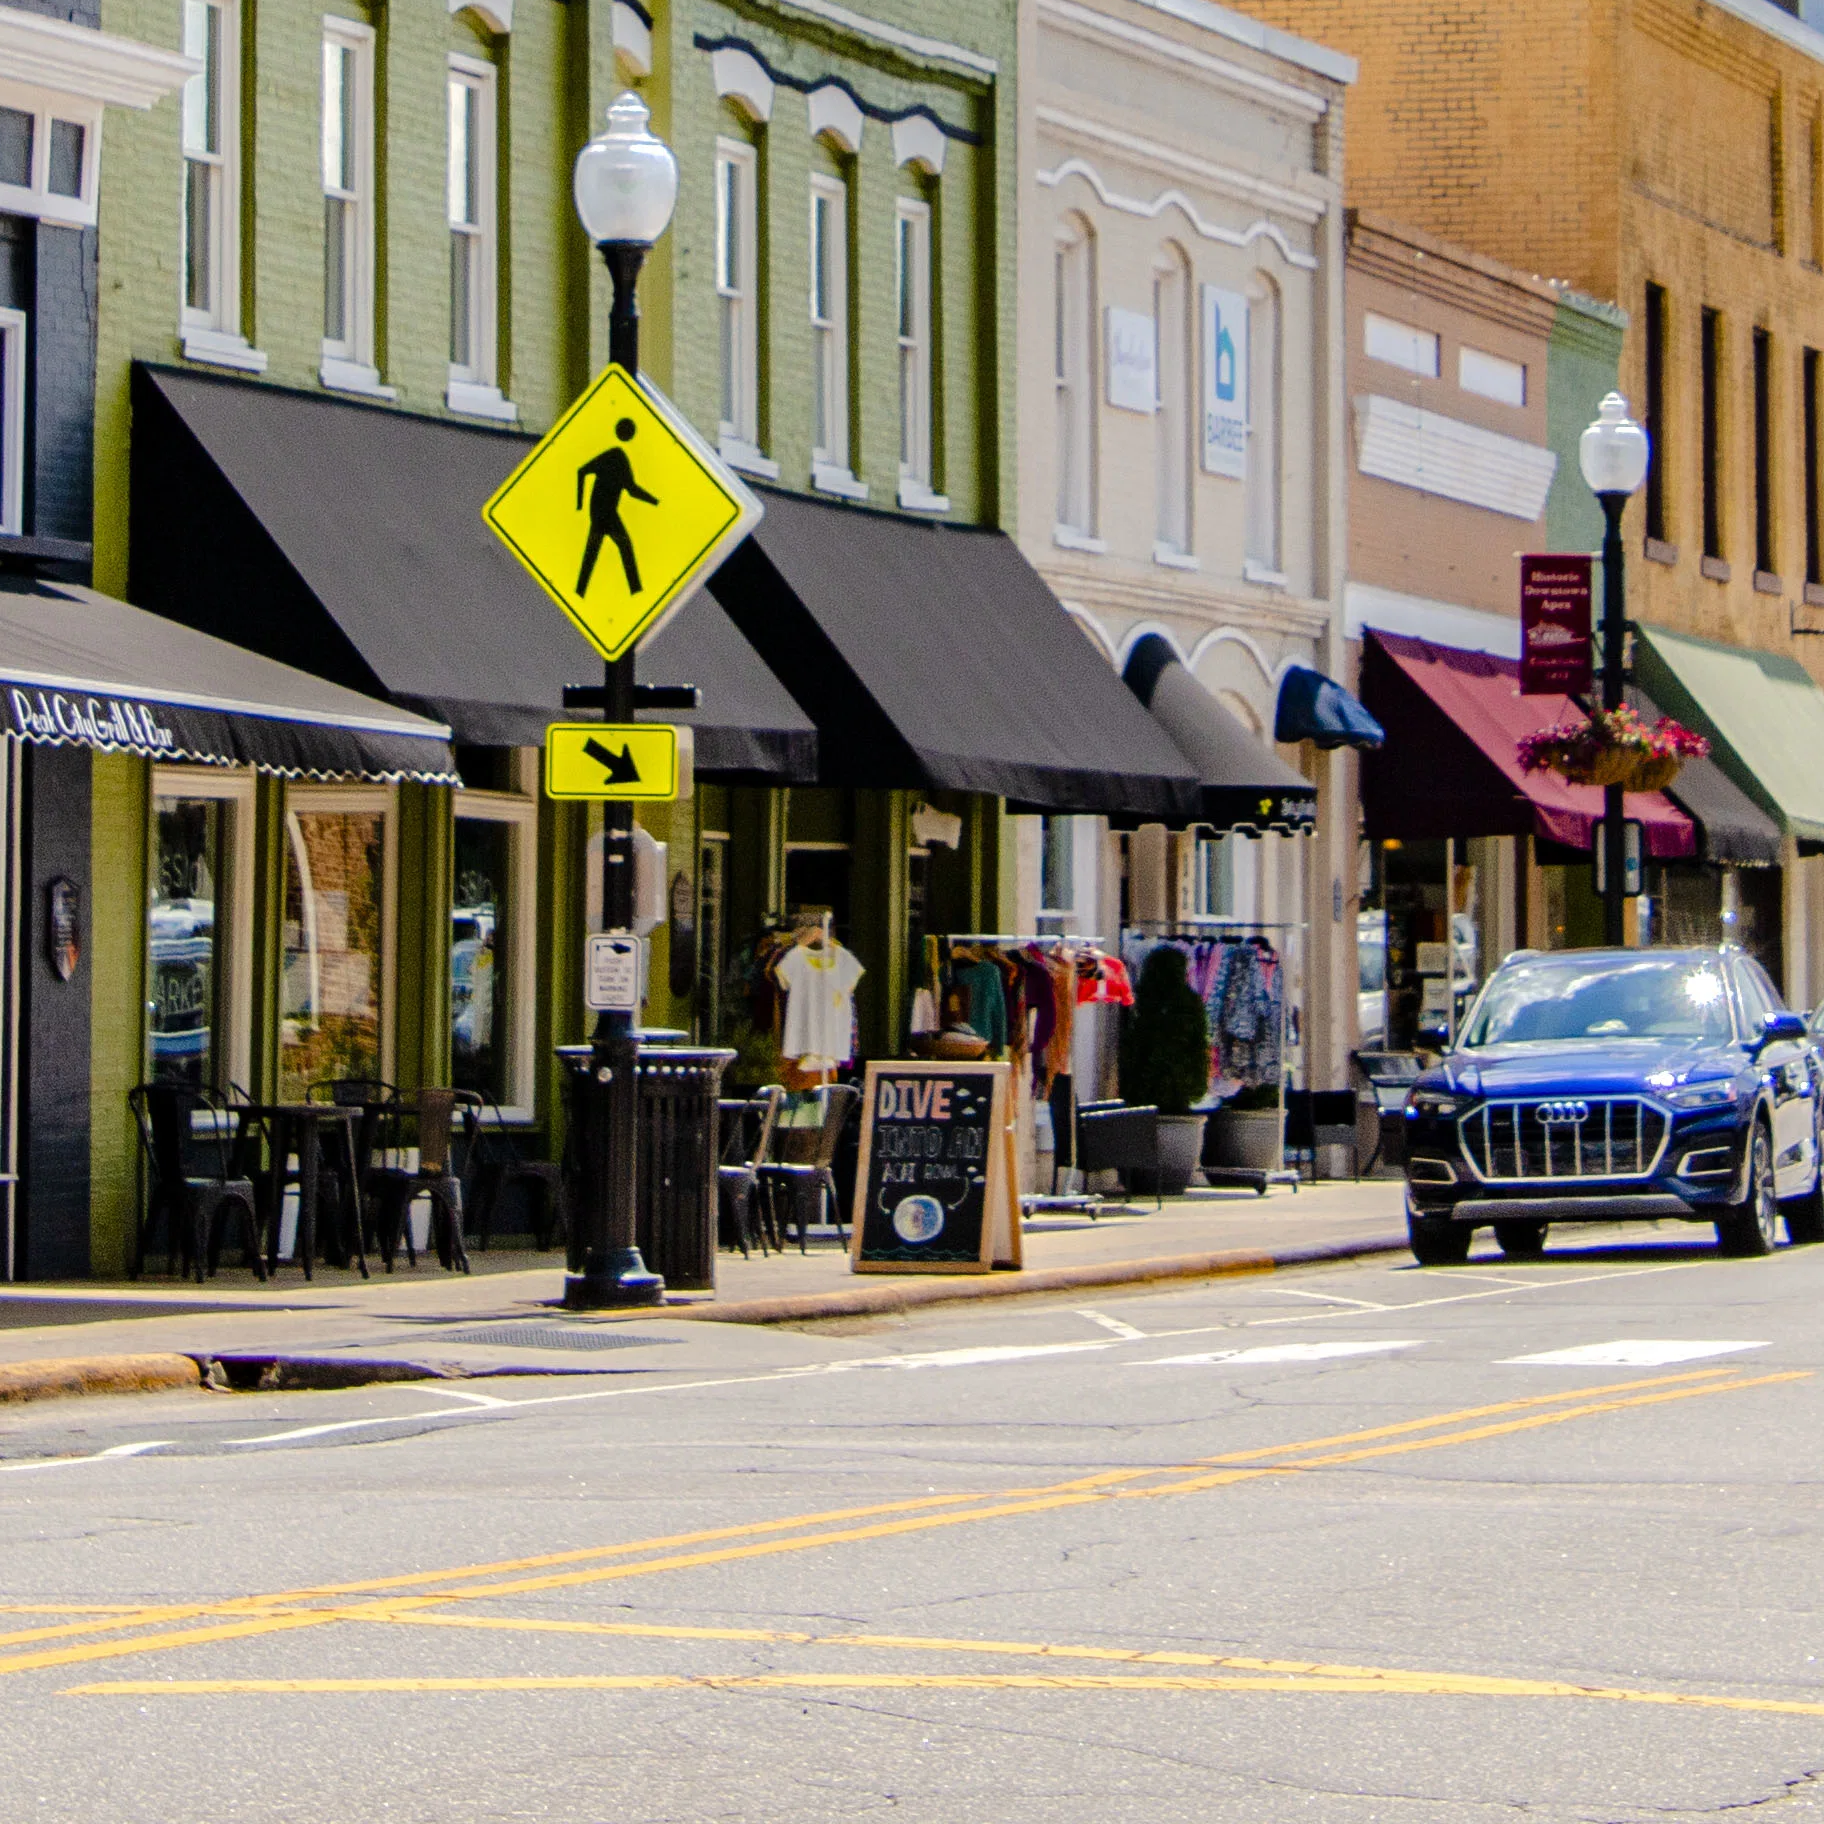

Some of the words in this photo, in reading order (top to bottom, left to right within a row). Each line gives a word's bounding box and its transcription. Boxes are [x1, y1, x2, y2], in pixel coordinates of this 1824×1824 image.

[1530, 571, 1581, 582] Historic
[1523, 585, 1588, 596] Downtown
[1540, 599, 1572, 612] Apex
[12, 688, 57, 734] Peak
[52, 693, 97, 744] City
[87, 697, 132, 744] Grill
[123, 701, 147, 745] &
[138, 704, 174, 747] Bar
[878, 1079, 955, 1120] DIVE
